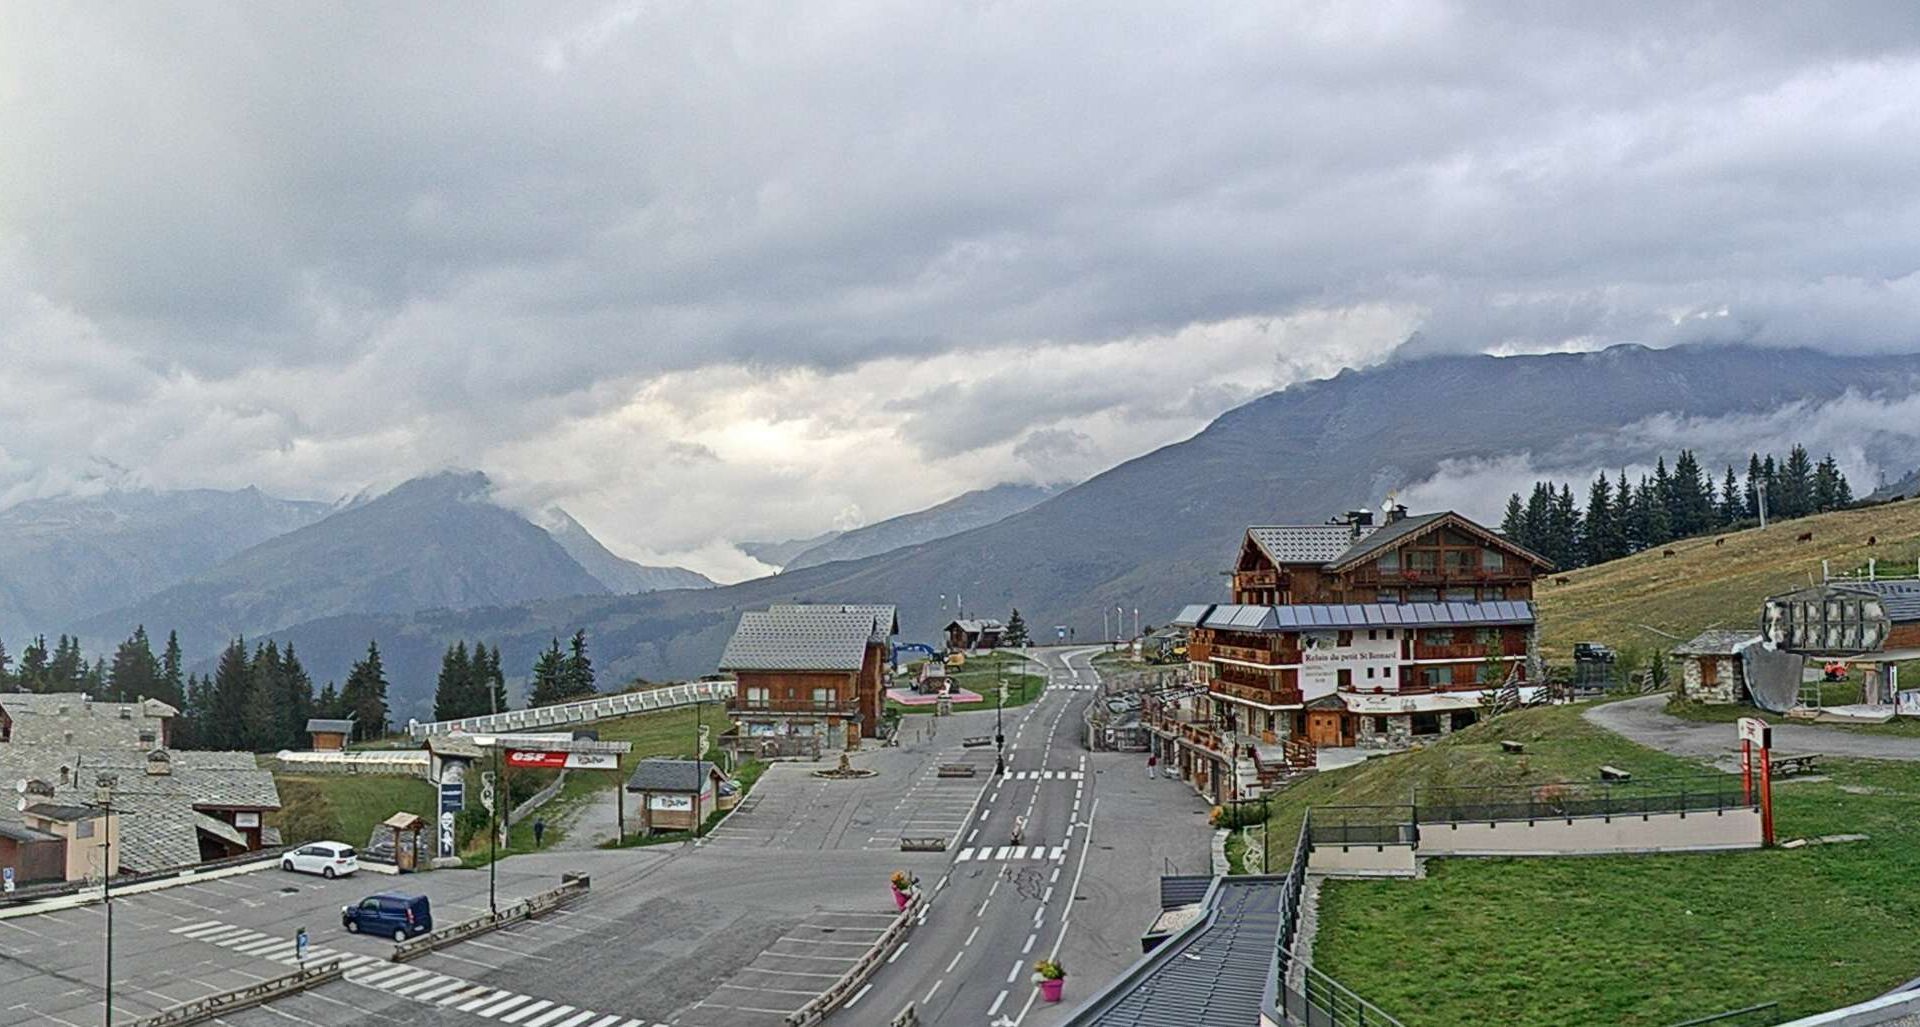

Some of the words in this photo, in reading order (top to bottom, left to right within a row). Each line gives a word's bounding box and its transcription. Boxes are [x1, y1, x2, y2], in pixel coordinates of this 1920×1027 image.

[1305, 653, 1328, 662] Relais
[1341, 653, 1358, 662] petit
[1369, 651, 1396, 660] Bernard
